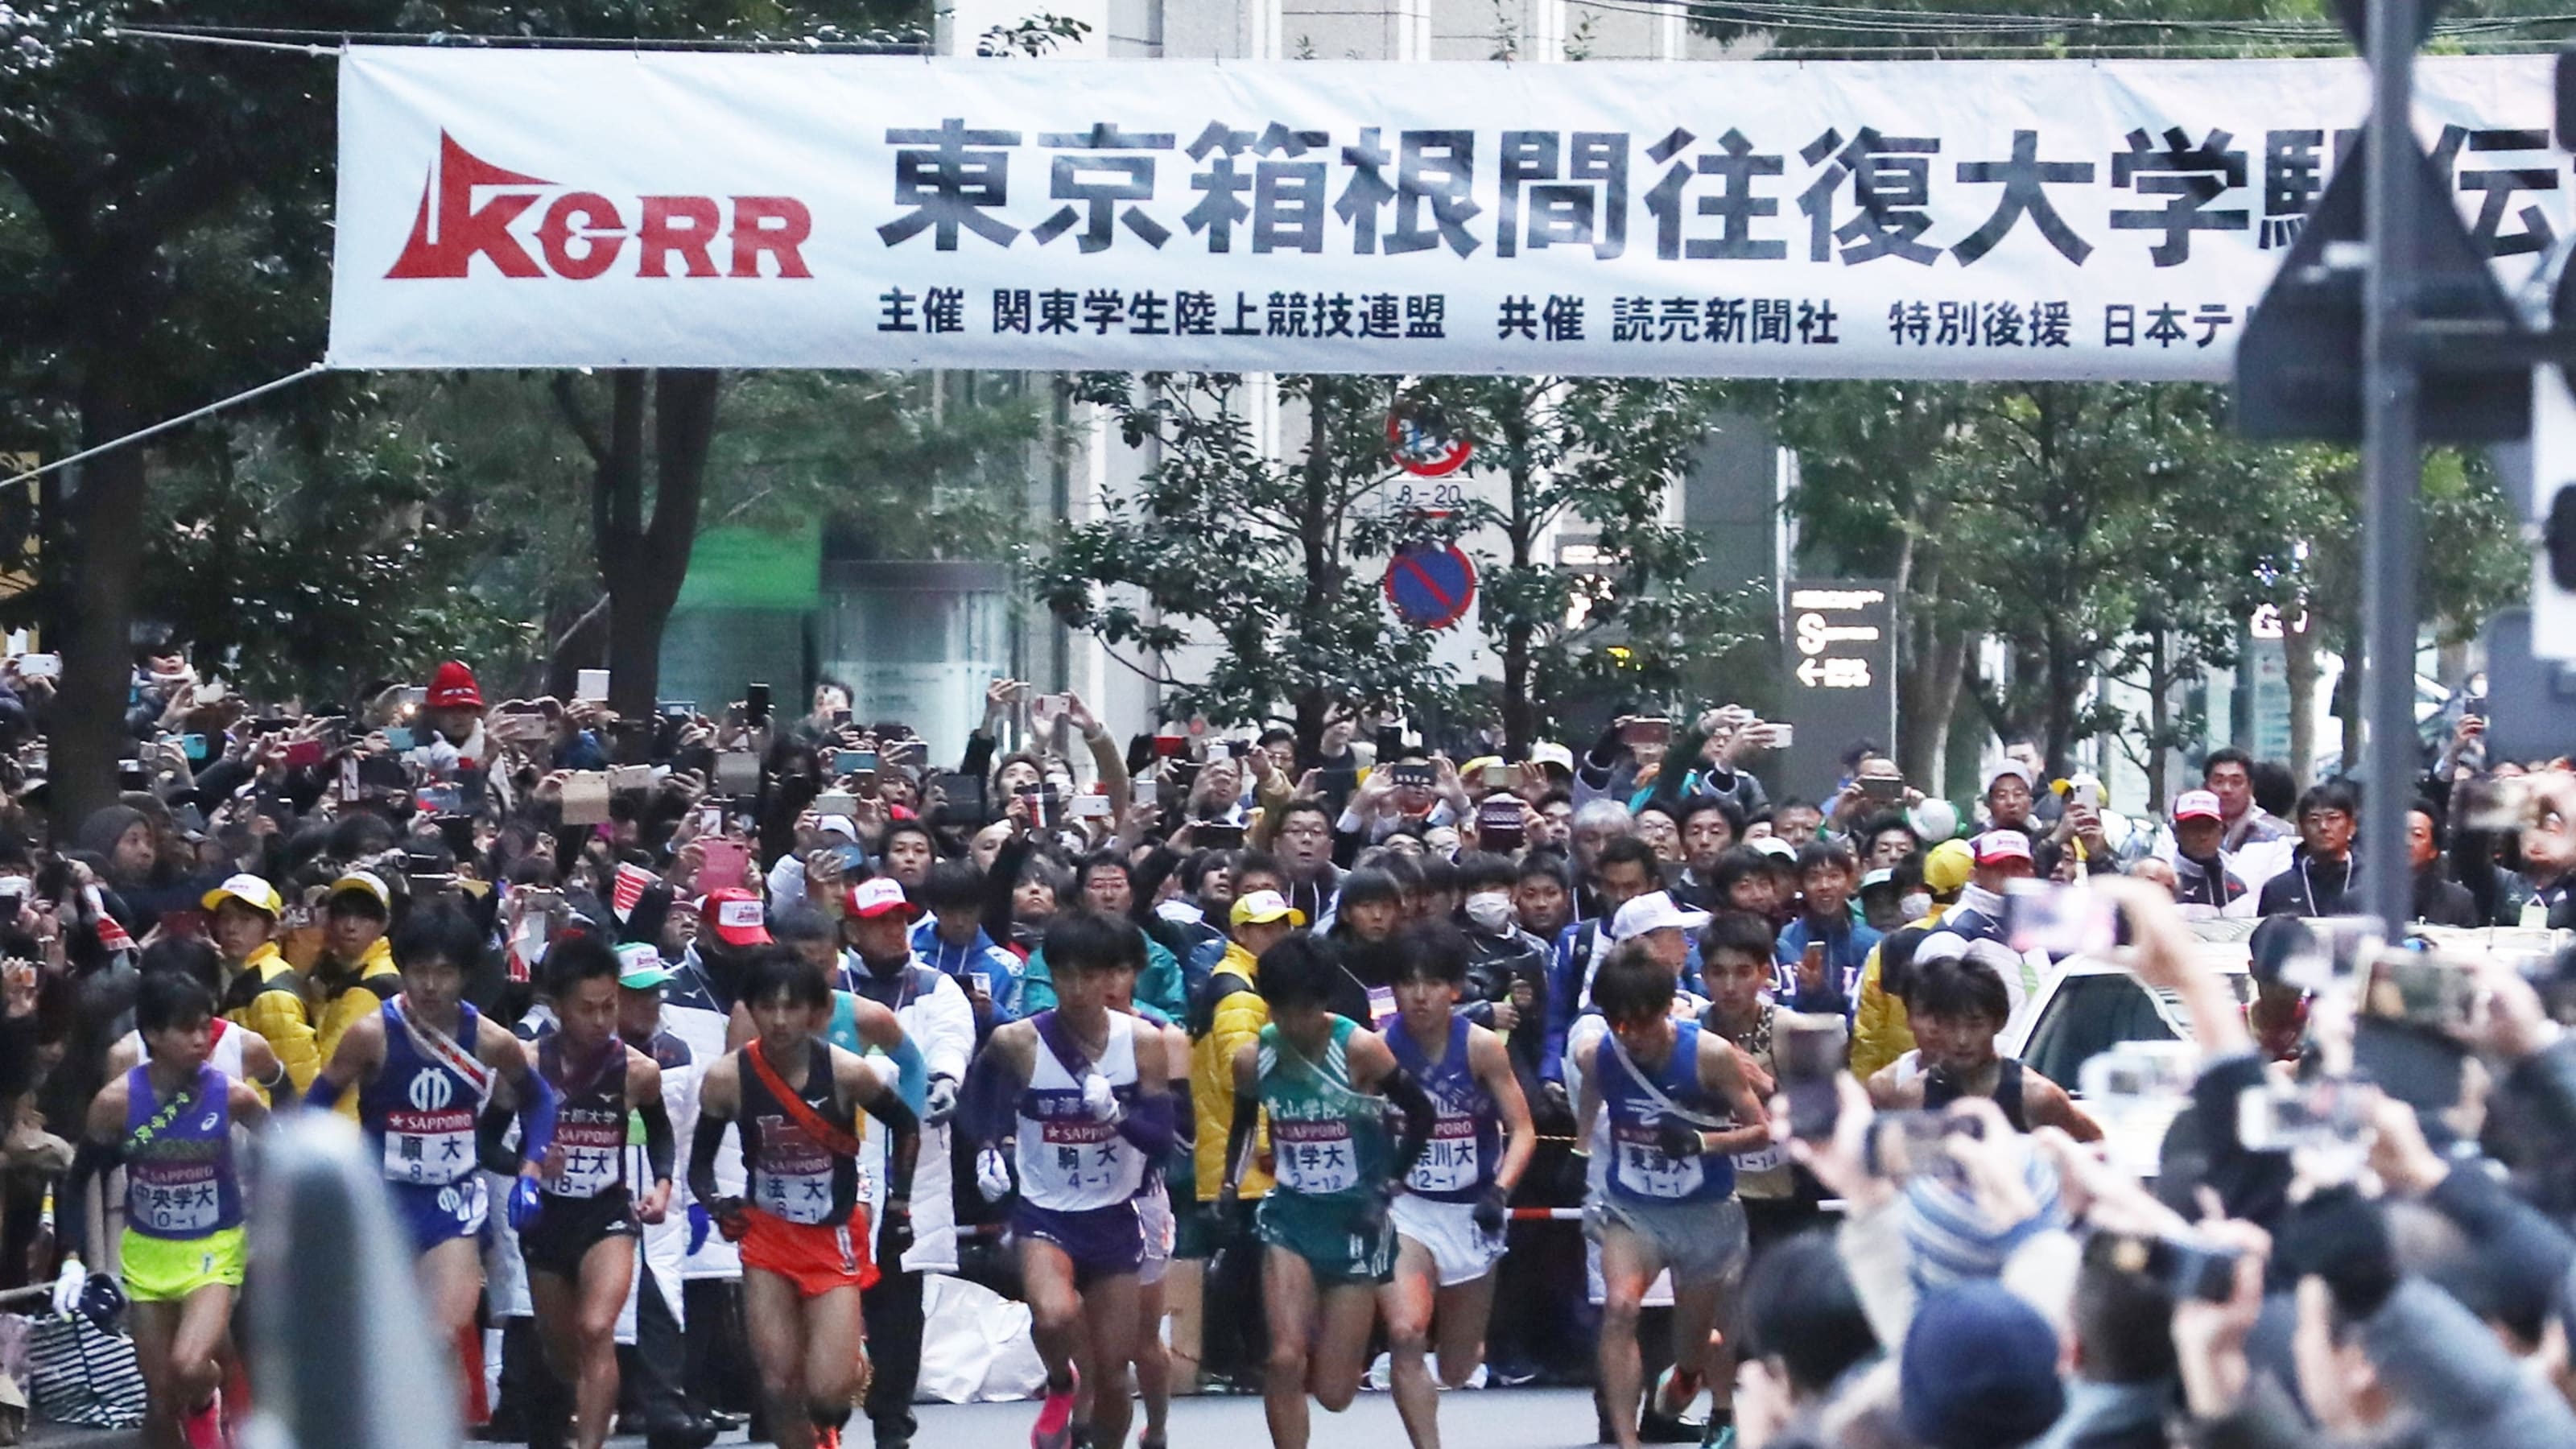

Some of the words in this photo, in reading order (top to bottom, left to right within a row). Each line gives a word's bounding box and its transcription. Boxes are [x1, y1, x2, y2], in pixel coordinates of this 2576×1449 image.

[877, 286, 964, 333] 主催
[993, 287, 1447, 340] 関東学生陸上競技連盟
[1497, 294, 1586, 342] 共催
[1612, 295, 1839, 345] 読売新聞社
[1889, 299, 2071, 349] 特別後援
[2104, 301, 2253, 349] 日本テ
[408, 1113, 473, 1130] SAPPORO
[1067, 1171, 1110, 1188] 4-1
